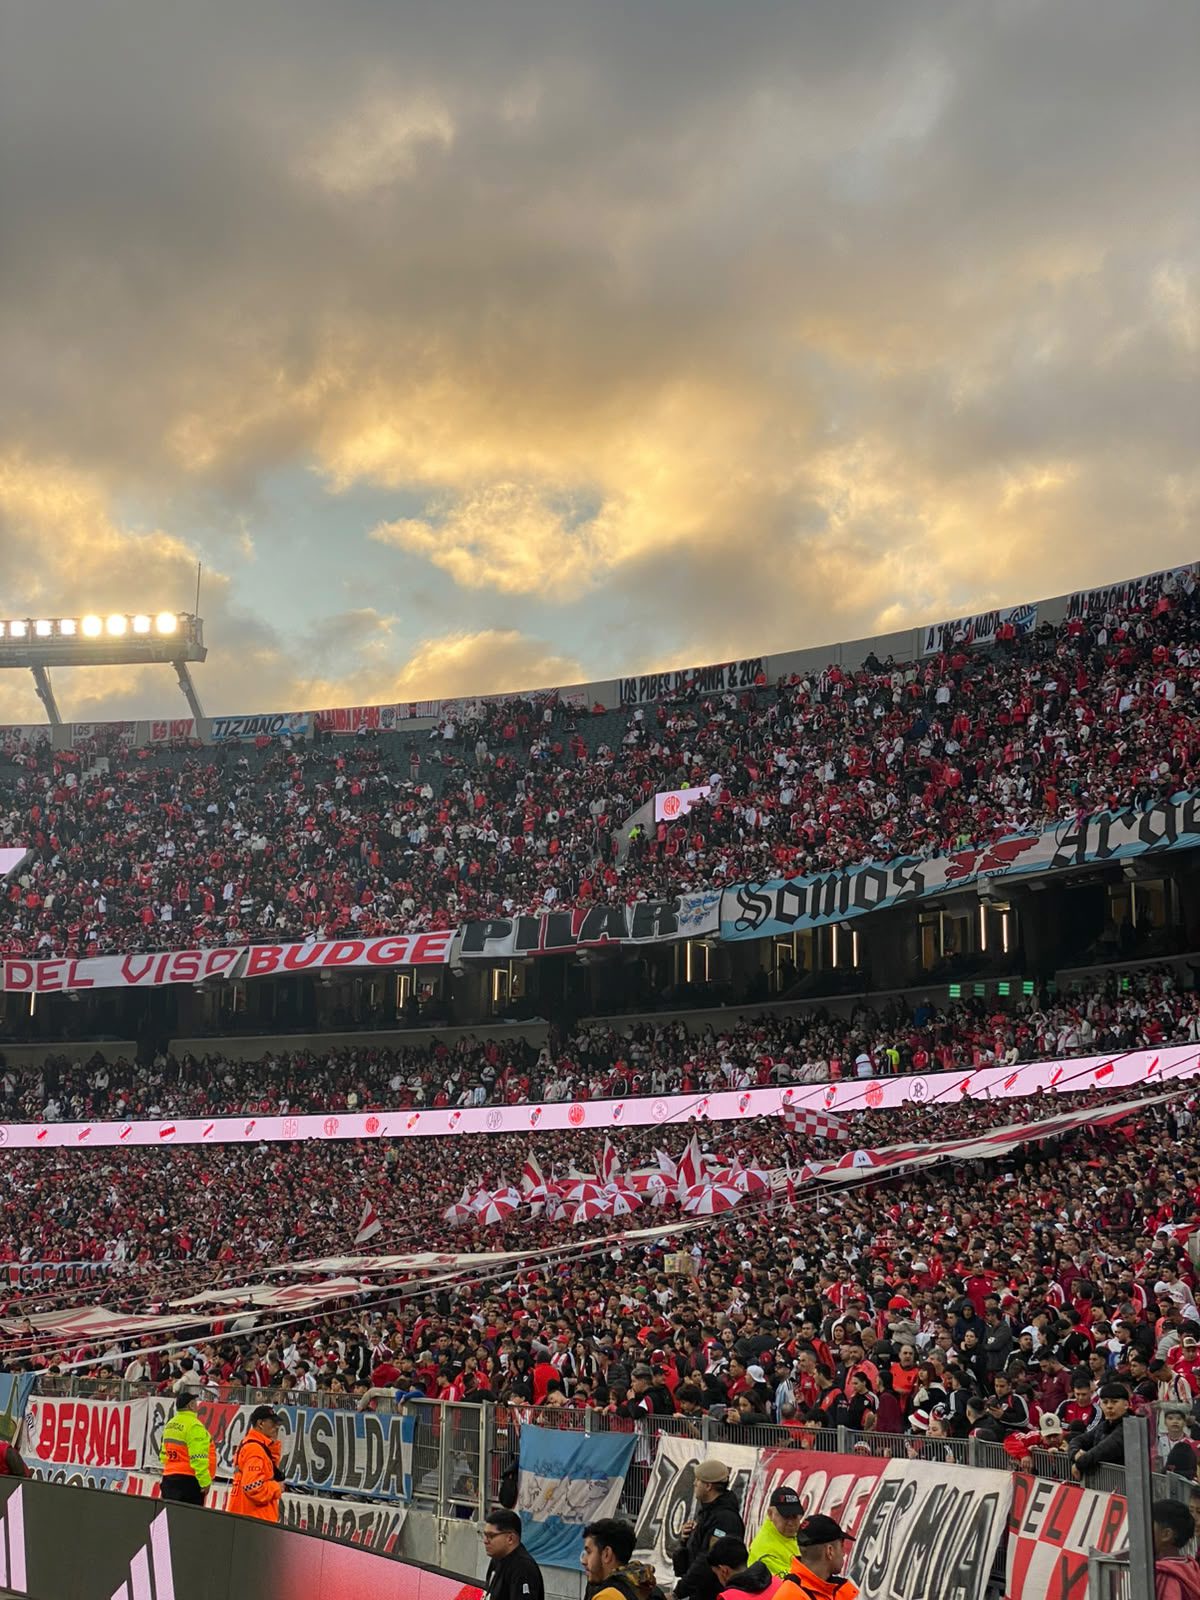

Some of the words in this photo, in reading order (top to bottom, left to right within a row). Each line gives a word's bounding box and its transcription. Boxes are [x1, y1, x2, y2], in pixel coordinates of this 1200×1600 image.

[620, 677, 637, 703] LOS
[640, 672, 671, 700] PIBES
[728, 662, 738, 688] &
[214, 715, 285, 737] TIZIANO
[734, 856, 926, 932] Somos
[460, 900, 680, 952] PILAR
[5, 959, 94, 991] DEL
[121, 949, 238, 985] VISO
[246, 932, 452, 977] BUDGE
[36, 1402, 137, 1467] BERNAL
[850, 1478, 917, 1591] ES
[892, 1482, 999, 1600] MIA
[1010, 1476, 1128, 1553] DELIR
